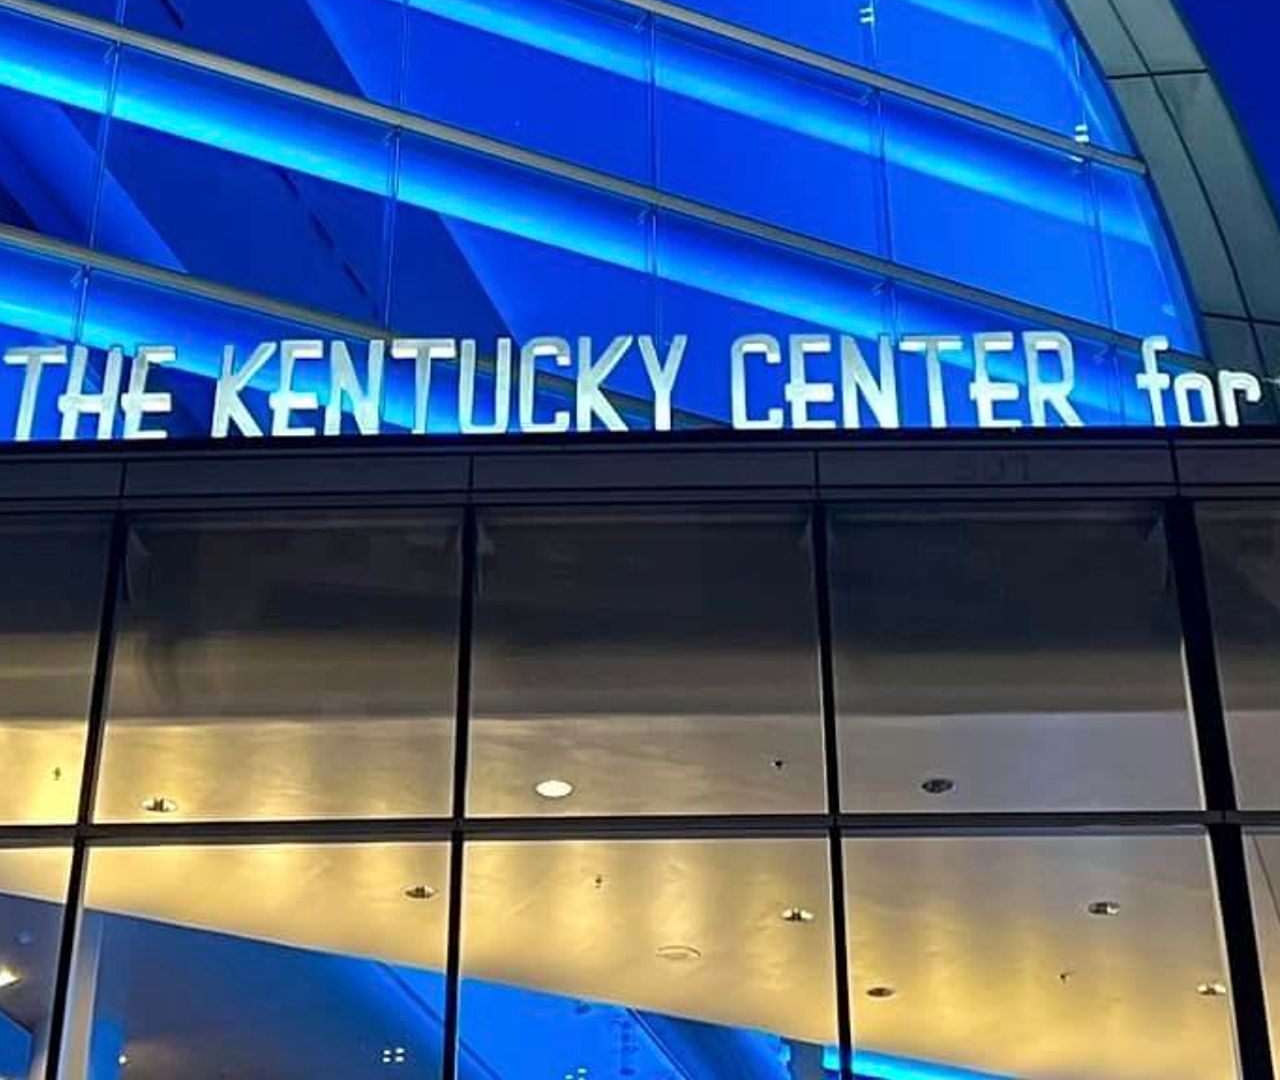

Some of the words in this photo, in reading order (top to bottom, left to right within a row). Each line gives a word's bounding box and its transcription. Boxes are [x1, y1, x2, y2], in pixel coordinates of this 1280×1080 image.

[3, 344, 176, 441] THE
[211, 333, 687, 437] KENTUCKY
[730, 331, 1084, 430] CENTER
[1136, 335, 1261, 427] for
